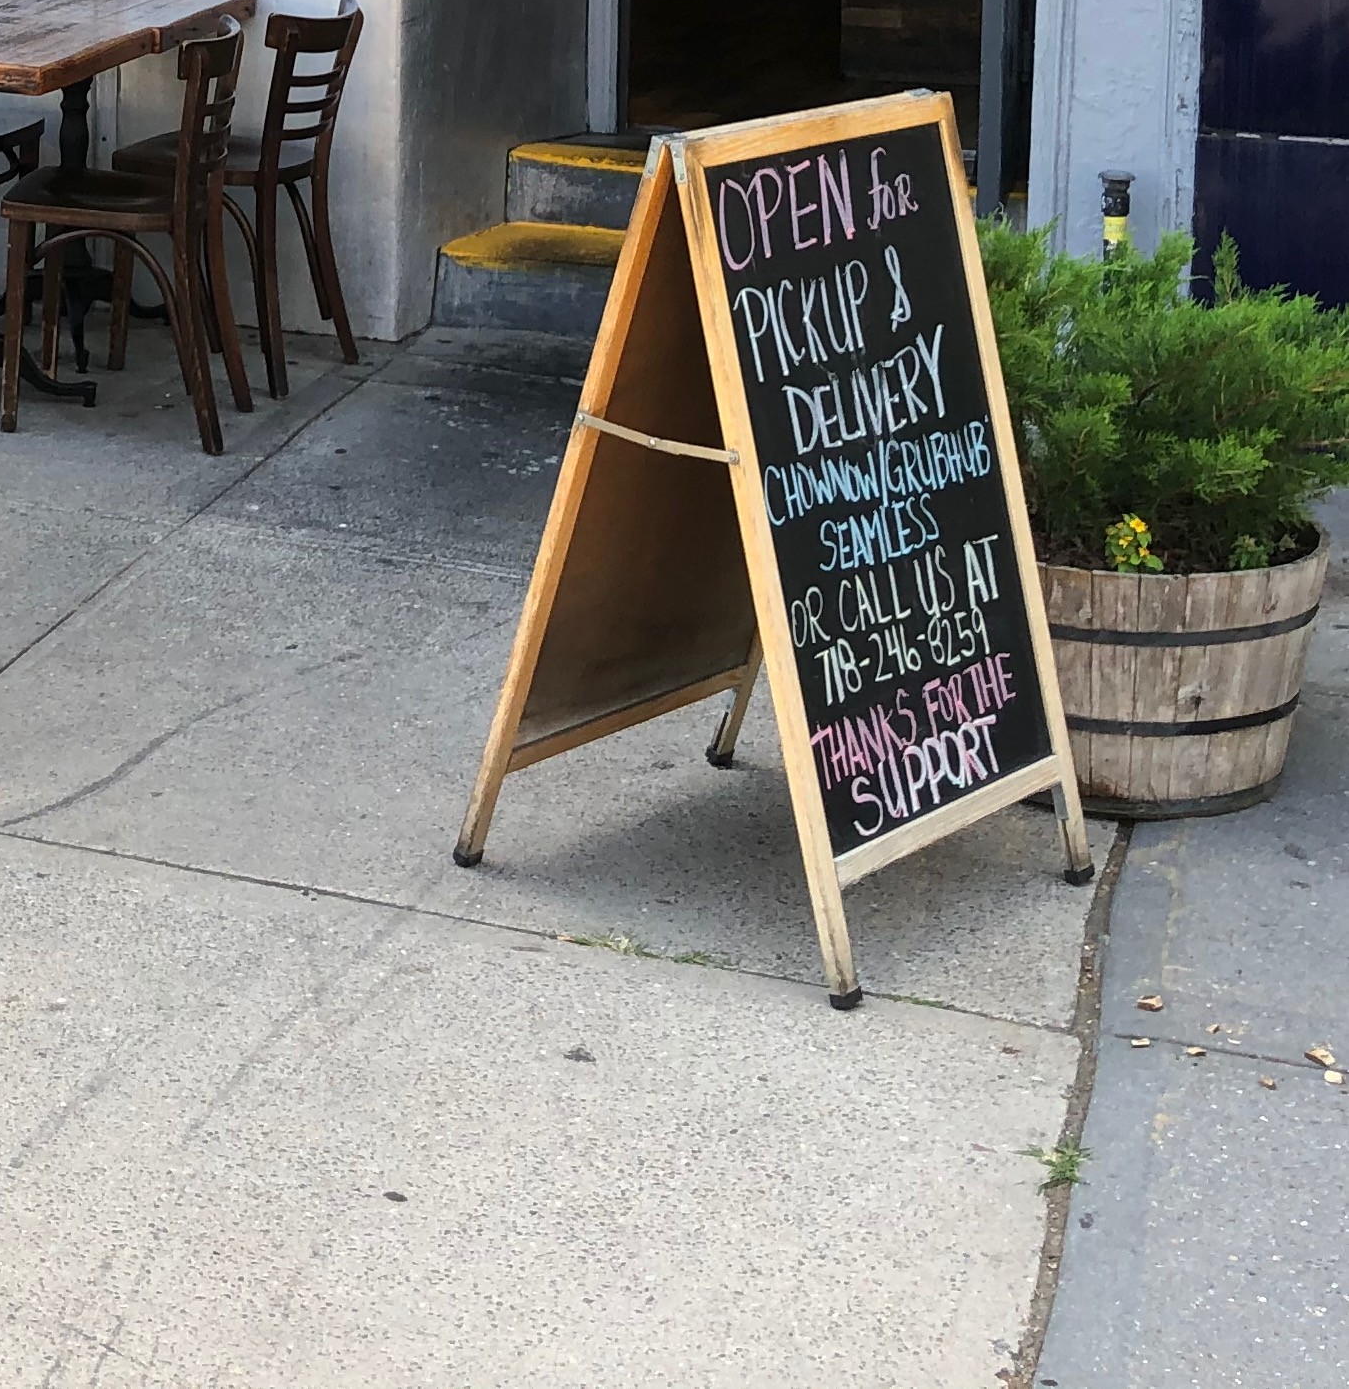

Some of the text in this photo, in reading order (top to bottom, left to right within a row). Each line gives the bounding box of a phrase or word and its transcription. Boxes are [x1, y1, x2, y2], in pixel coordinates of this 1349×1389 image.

[719, 149, 855, 271] OPEN
[733, 260, 868, 382] PICKUP
[781, 324, 944, 455] DELIVERY
[791, 534, 998, 647] OR CALL US AT
[819, 493, 939, 571] SEAMLESS
[814, 607, 990, 706] 718-246-8259
[810, 653, 1017, 790] THANKS FOR THE
[851, 714, 999, 836] SUPPORT
